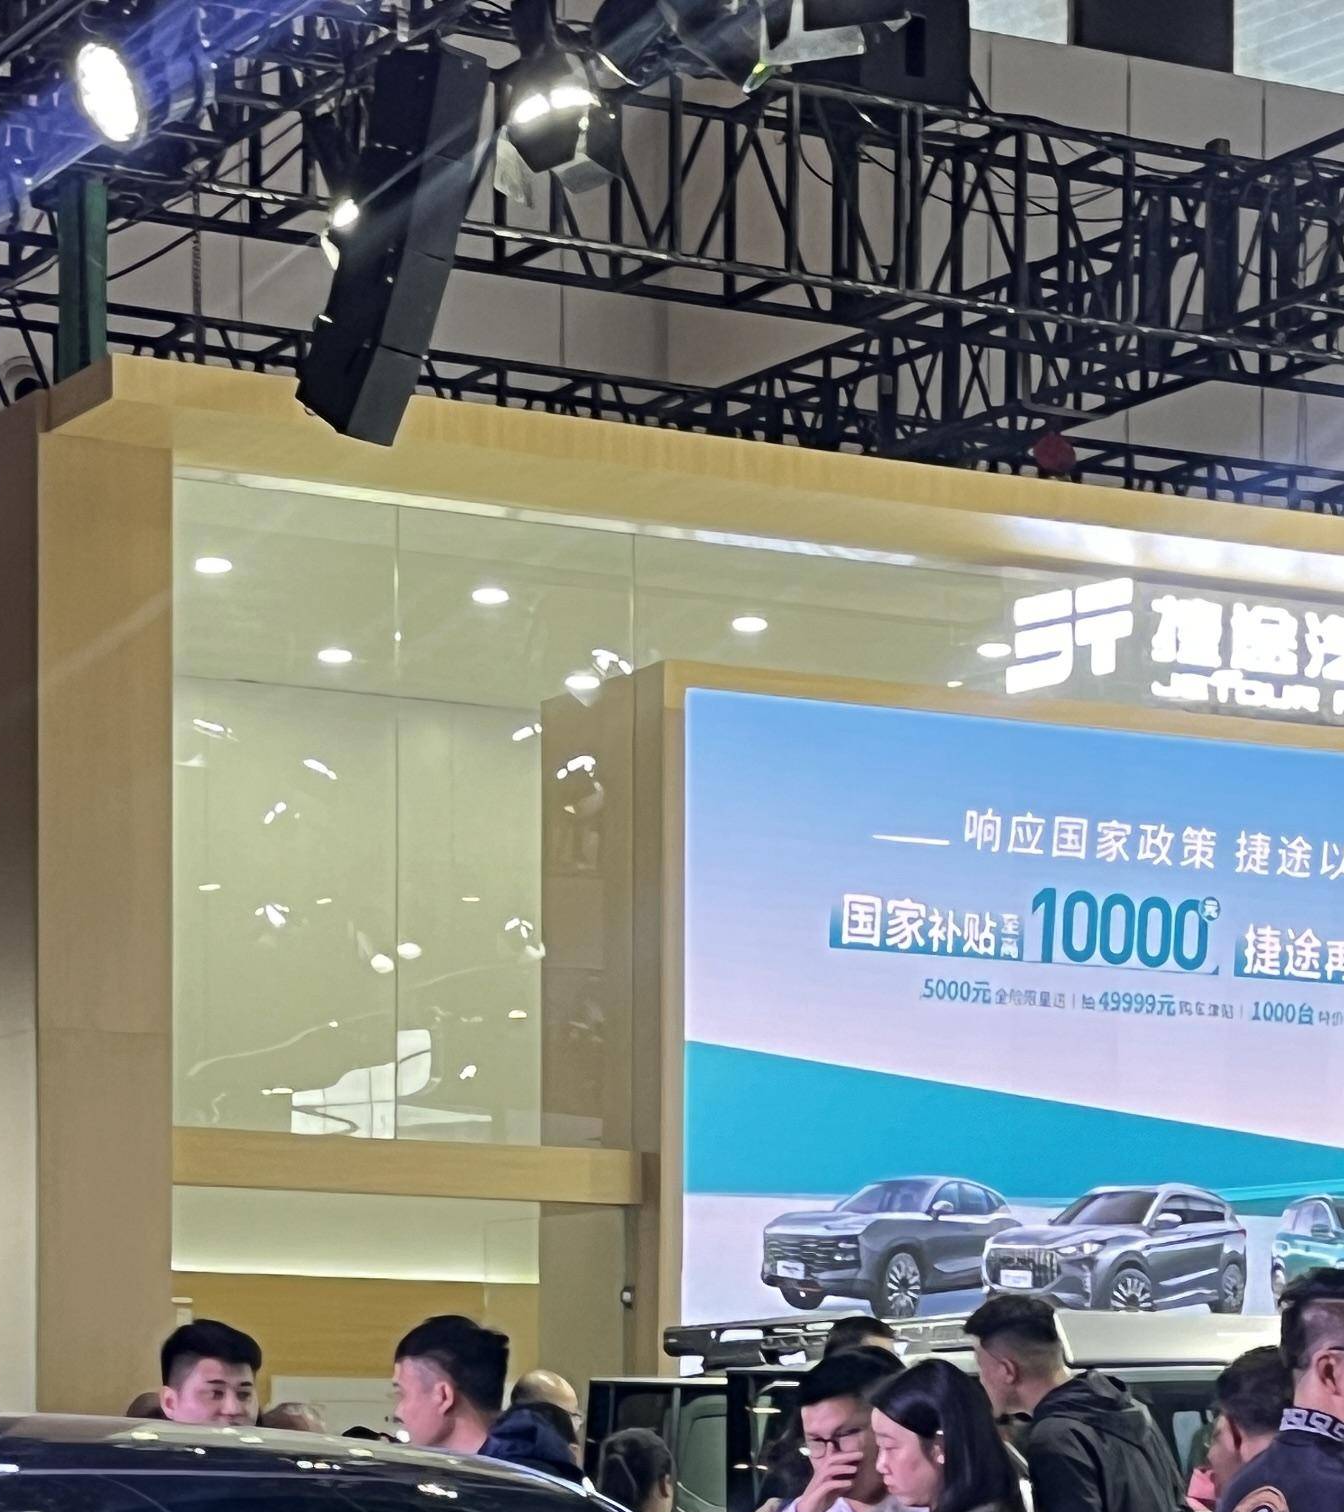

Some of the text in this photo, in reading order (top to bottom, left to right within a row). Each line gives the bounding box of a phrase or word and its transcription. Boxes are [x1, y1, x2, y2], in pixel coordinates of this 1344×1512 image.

[964, 807, 1217, 870] 响应国家政策
[841, 892, 998, 957] 国家补贴
